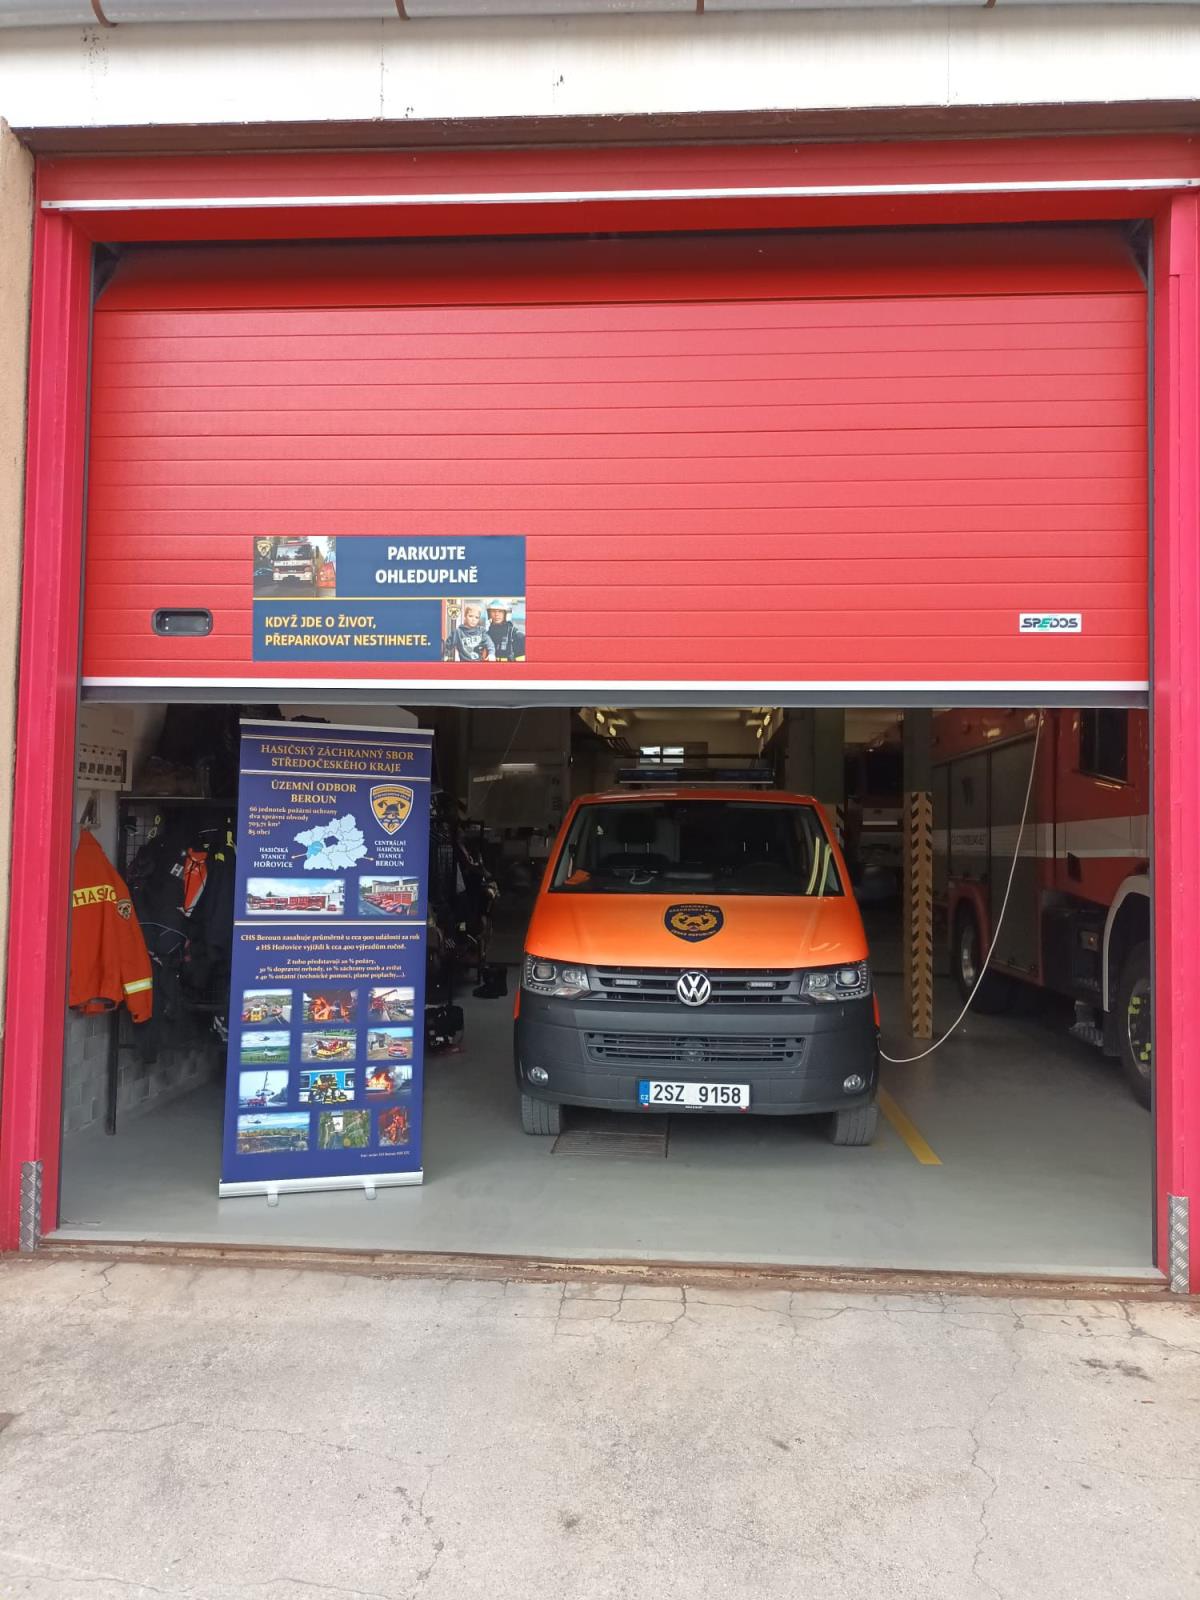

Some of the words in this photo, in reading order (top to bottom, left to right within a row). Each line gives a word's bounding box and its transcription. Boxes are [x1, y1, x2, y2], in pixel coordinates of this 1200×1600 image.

[387, 546, 466, 560] PARKUJTE
[375, 566, 478, 584] OHLEDUPLNĚ
[265, 614, 298, 628] KDYŽ
[300, 616, 322, 628] JDE
[325, 617, 335, 628] O
[338, 614, 377, 629] ŽIVOT,
[1021, 618, 1078, 628] SPEDOS
[265, 632, 350, 646] PŘEPARKOVAT
[354, 634, 432, 646] NESTIHNETE.
[261, 744, 315, 756] HASIČSKÝ
[318, 746, 384, 758] ZÁCHRANNÝ
[386, 750, 414, 760] SBOR
[272, 757, 367, 770] STŘEDOČESKÉHO
[370, 762, 401, 773] KRAJE
[271, 779, 314, 791] ÚZEMNÍ
[316, 782, 357, 792] ODBOR
[291, 794, 336, 804] BEROUN
[288, 807, 312, 815] požární
[253, 860, 293, 868] HOŘOVICE
[654, 1084, 685, 1102] 2SZ
[699, 1086, 741, 1104] 9158
